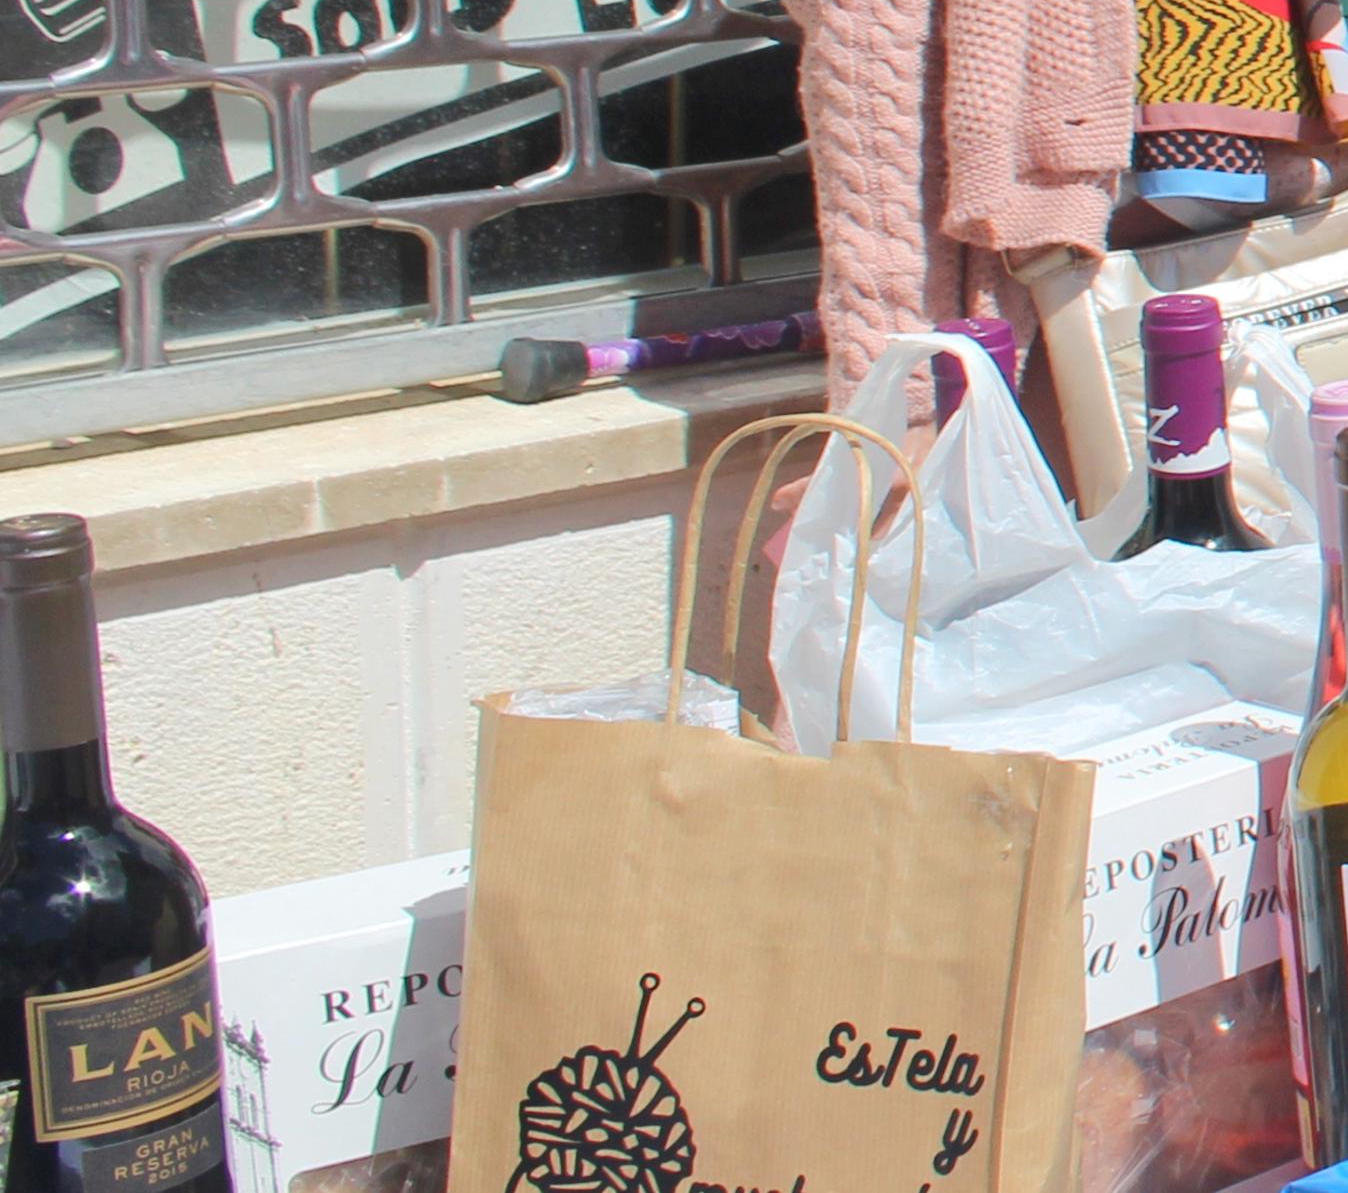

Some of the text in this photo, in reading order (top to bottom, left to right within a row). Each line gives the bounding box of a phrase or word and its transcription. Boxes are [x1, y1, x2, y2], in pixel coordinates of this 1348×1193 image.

[69, 1001, 213, 1083] LAN
[126, 1060, 190, 1092] RIOJA
[114, 1136, 210, 1181] RESERVA
[136, 1128, 193, 1158] GRAN
